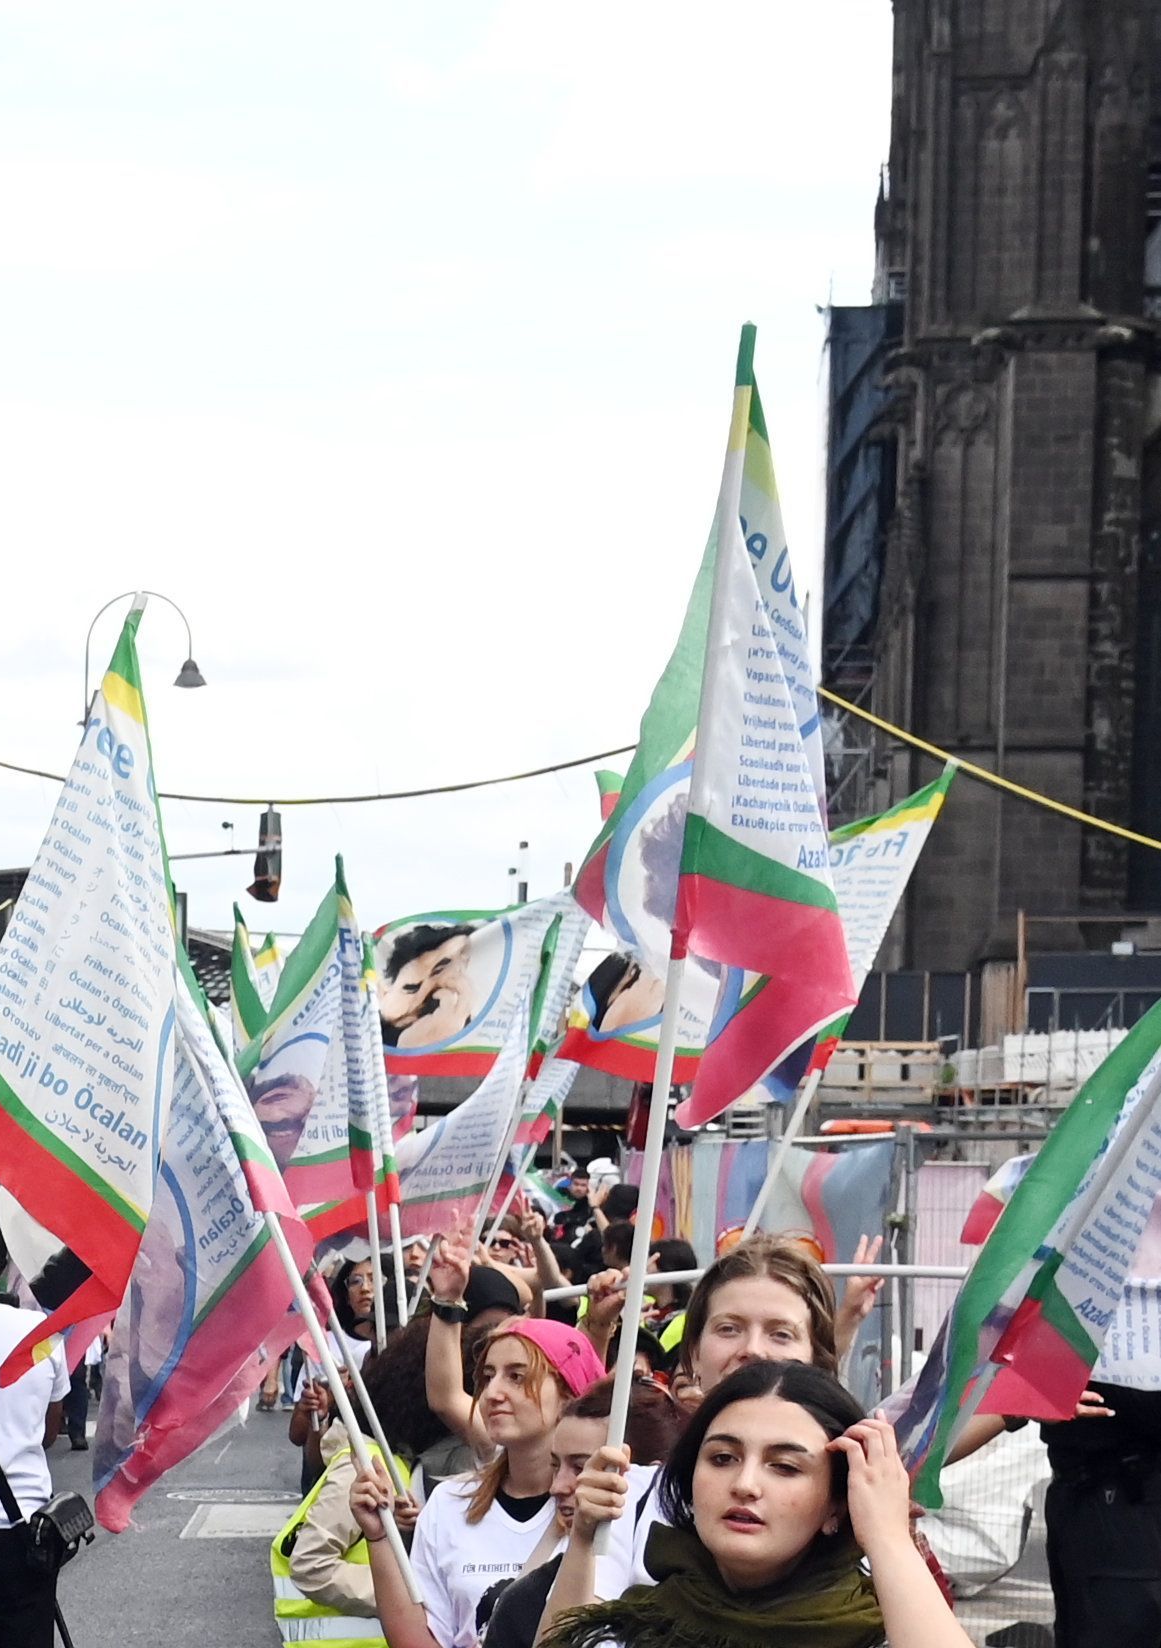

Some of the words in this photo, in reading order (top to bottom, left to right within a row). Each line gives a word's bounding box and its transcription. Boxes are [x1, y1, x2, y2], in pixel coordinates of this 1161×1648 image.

[80, 716, 134, 780] ree
[741, 734, 776, 752] Libertad
[61, 817, 92, 845] Ocalan
[53, 840, 83, 866] Ocalan
[84, 953, 114, 982] Frihet
[114, 972, 130, 989] för
[86, 1035, 102, 1054] per
[103, 1049, 110, 1059] a
[111, 1052, 144, 1082] Ocalan
[20, 1051, 41, 1079] ji
[39, 1062, 69, 1096] bo
[74, 1083, 148, 1151] Öcalan
[1074, 1297, 1114, 1329] Azad
